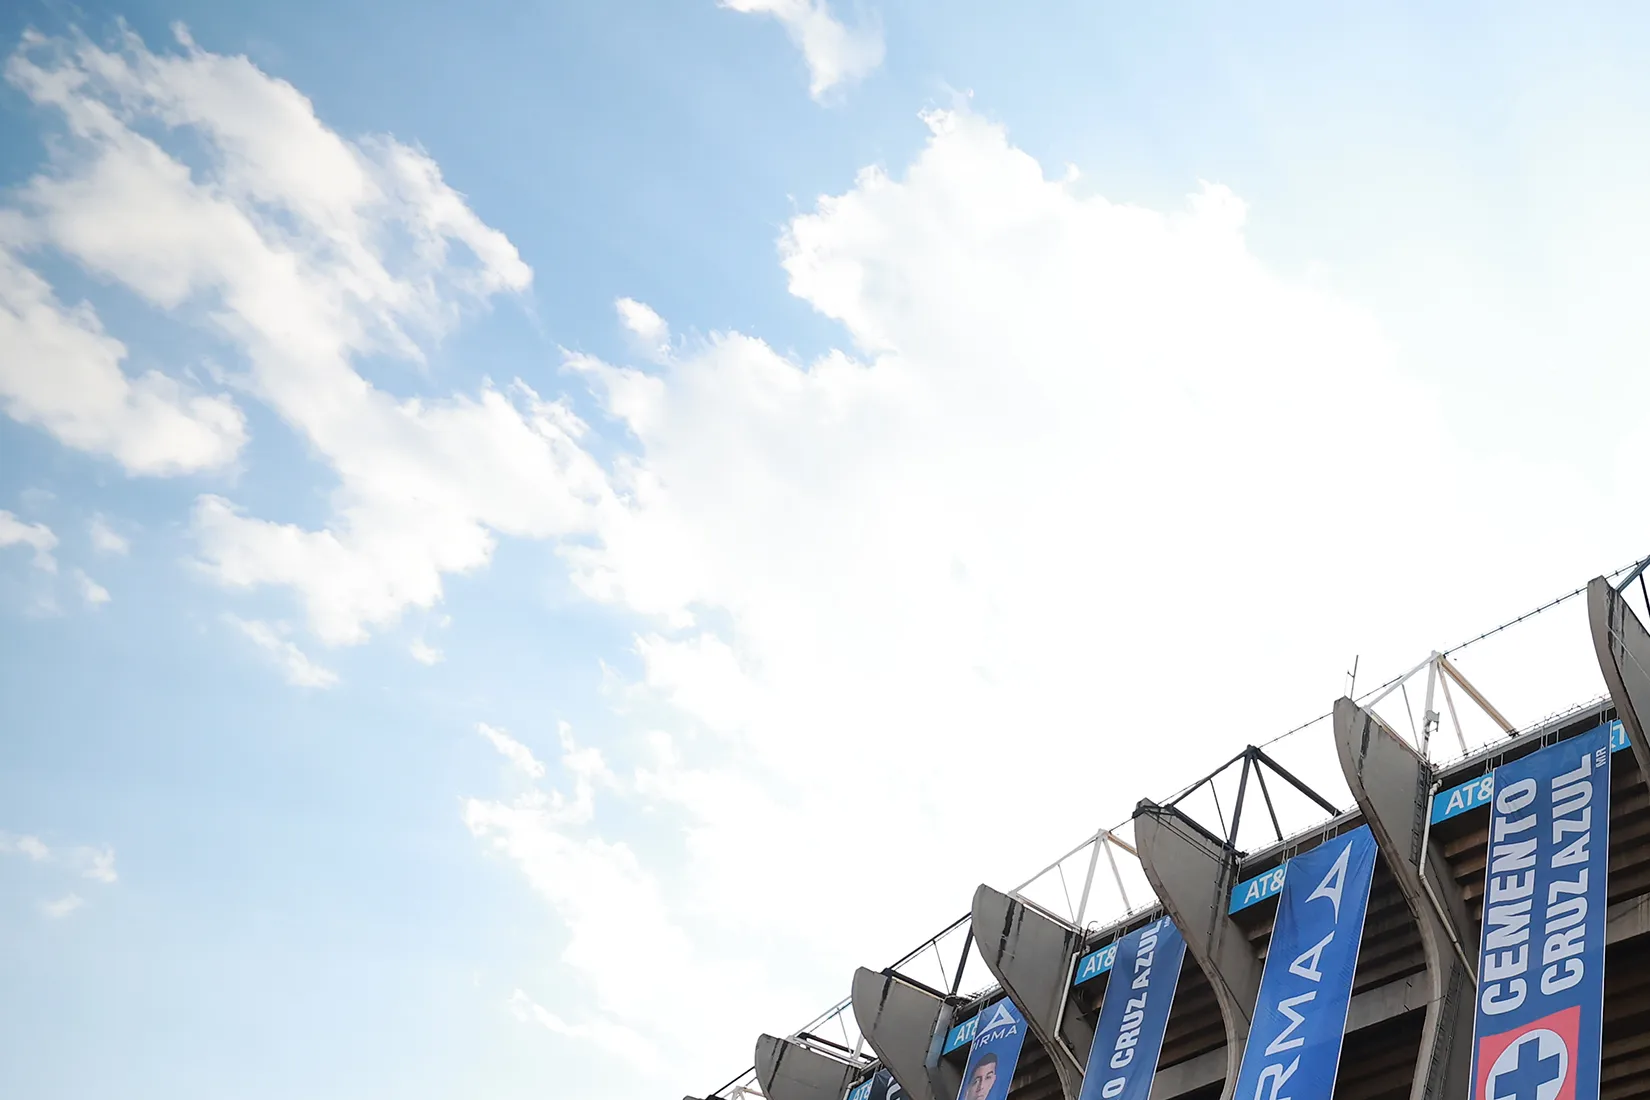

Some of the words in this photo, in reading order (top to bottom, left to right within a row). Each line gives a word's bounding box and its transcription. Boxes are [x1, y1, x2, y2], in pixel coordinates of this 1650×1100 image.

[1445, 777, 1493, 815] AT&
[1550, 753, 1593, 869] AZUL
[1244, 867, 1285, 904] AT&
[1481, 777, 1538, 1016] CEMENTO
[1540, 860, 1589, 996] CRUZ
[1083, 943, 1116, 978] AT&
[1109, 991, 1147, 1070] CRUZ
[1134, 920, 1163, 989] AZUL
